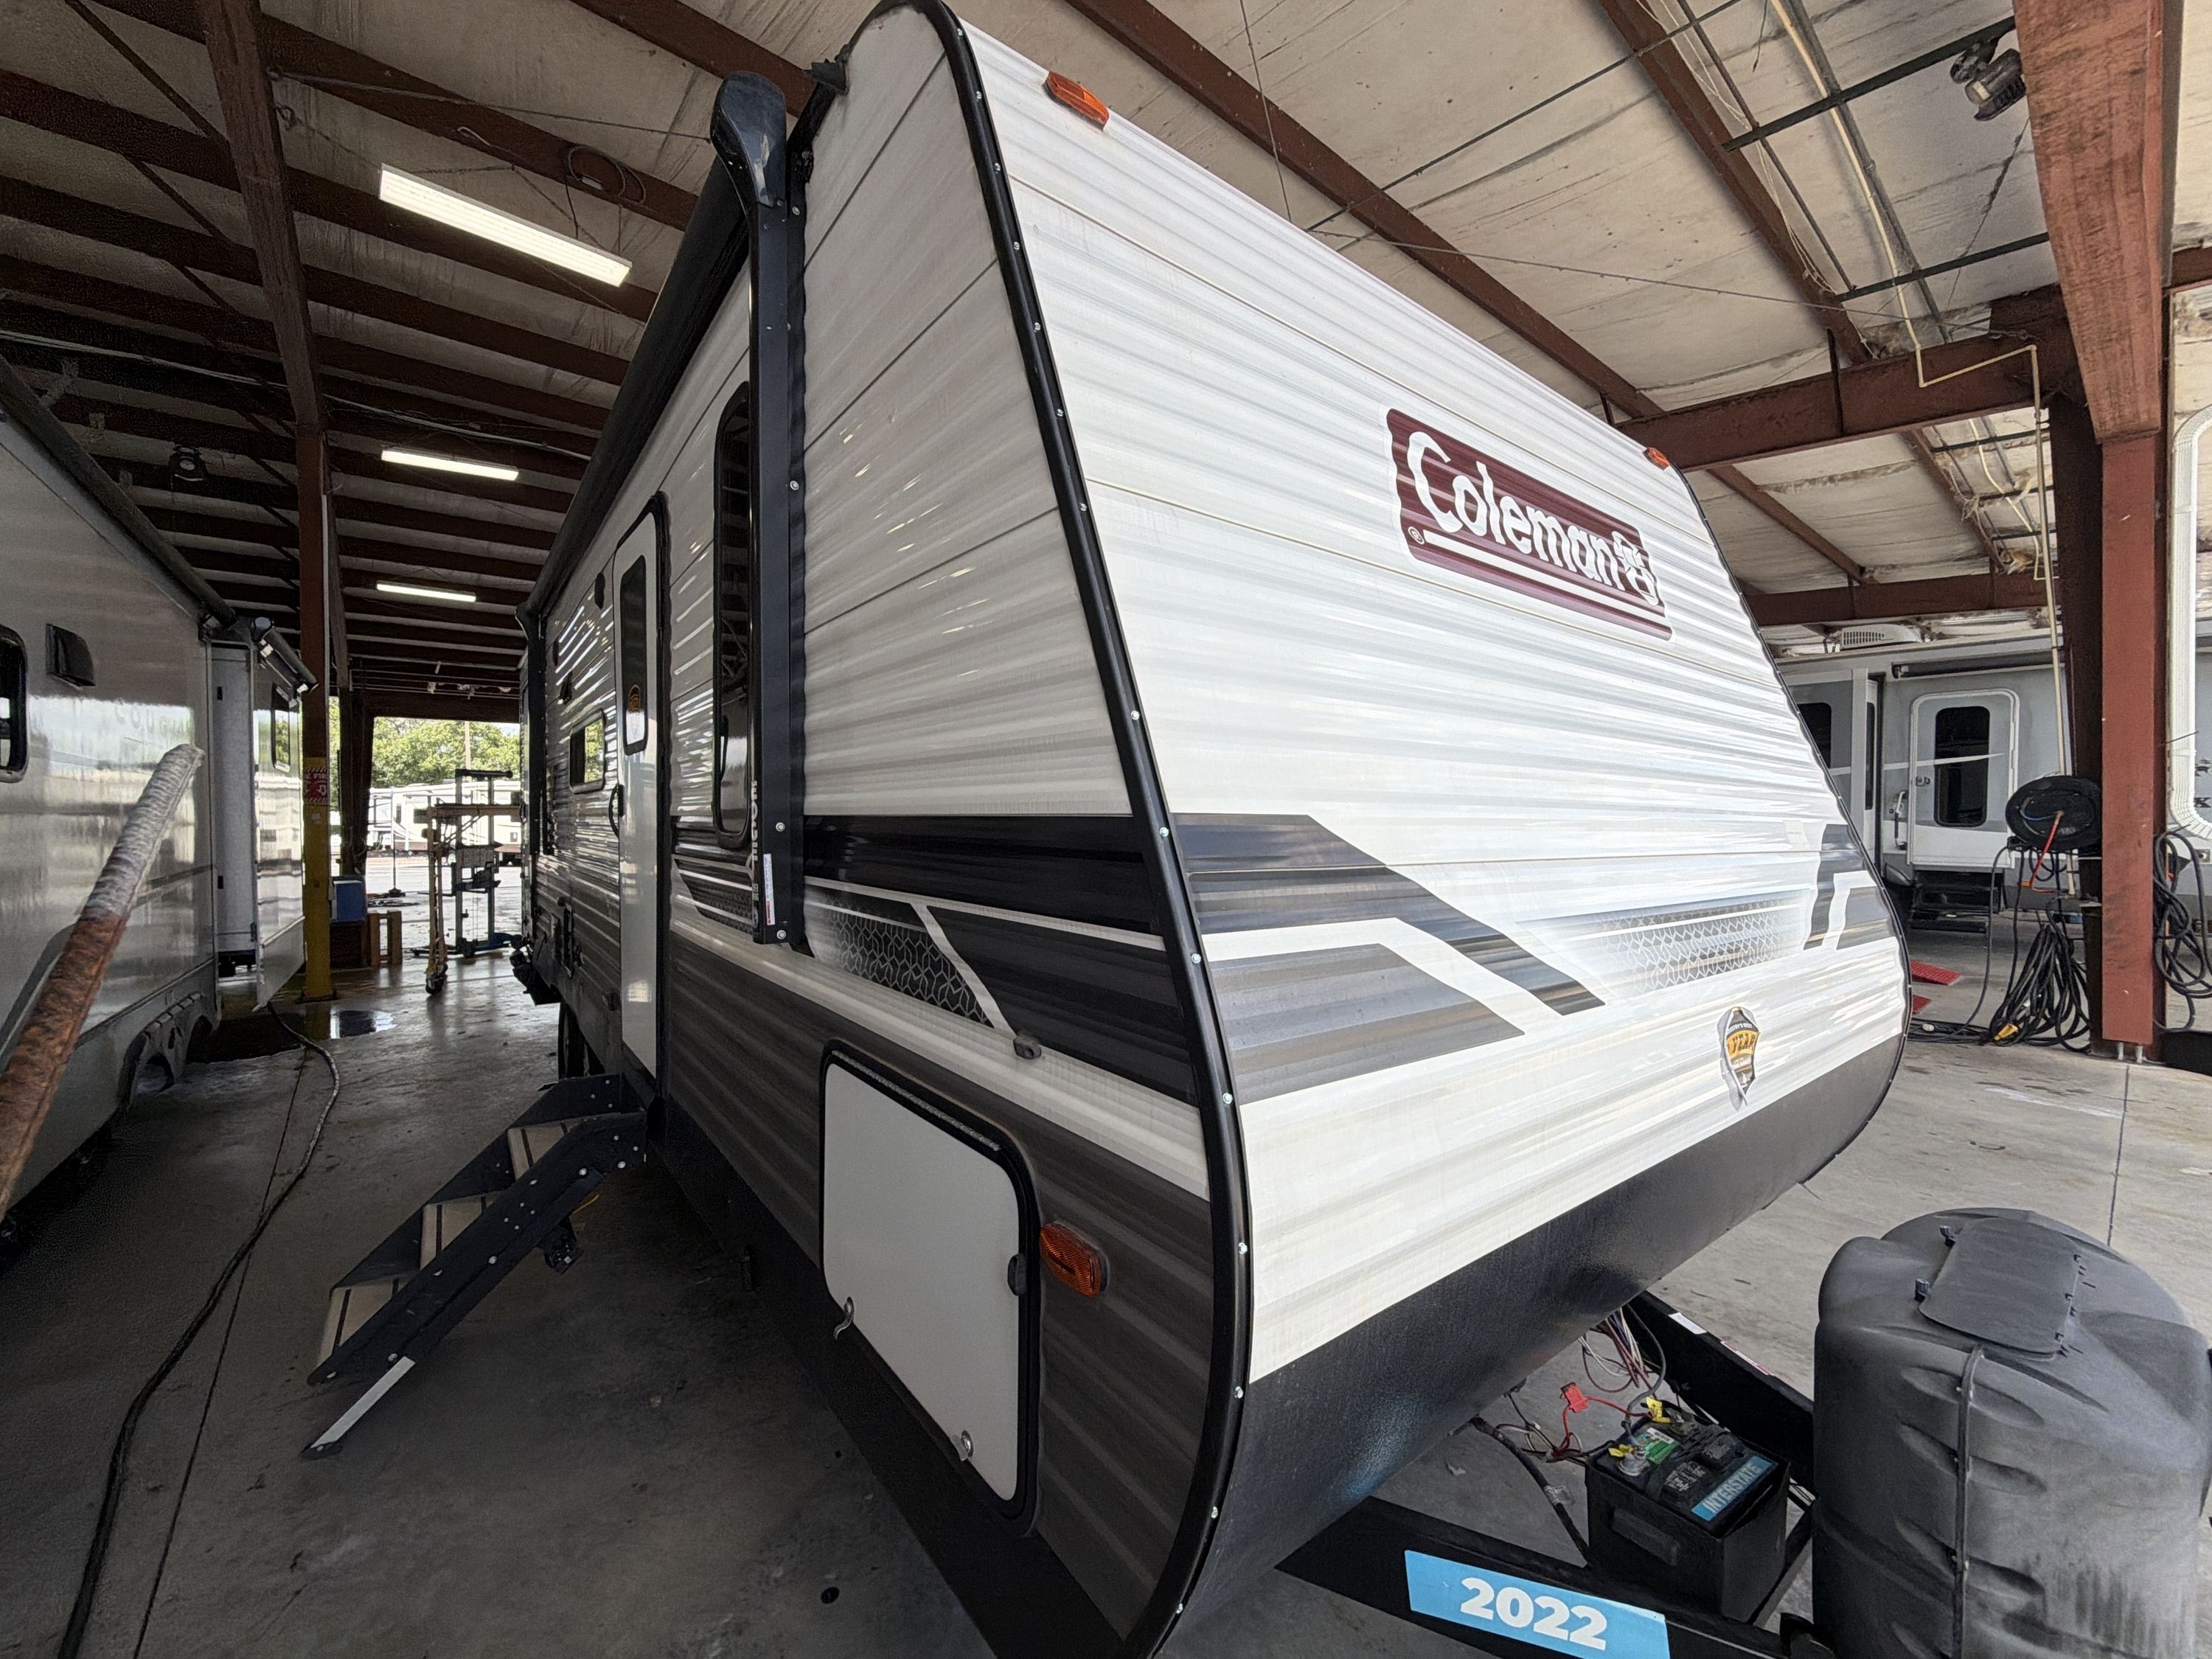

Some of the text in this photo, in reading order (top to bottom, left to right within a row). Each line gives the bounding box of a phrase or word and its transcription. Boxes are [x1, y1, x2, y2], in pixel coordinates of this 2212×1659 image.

[1407, 431, 1625, 591] Coleman
[1732, 1032, 1756, 1054] YEAR
[1702, 1462, 1762, 1514] INTERSTATE
[1460, 1577, 1607, 1651] 2022
